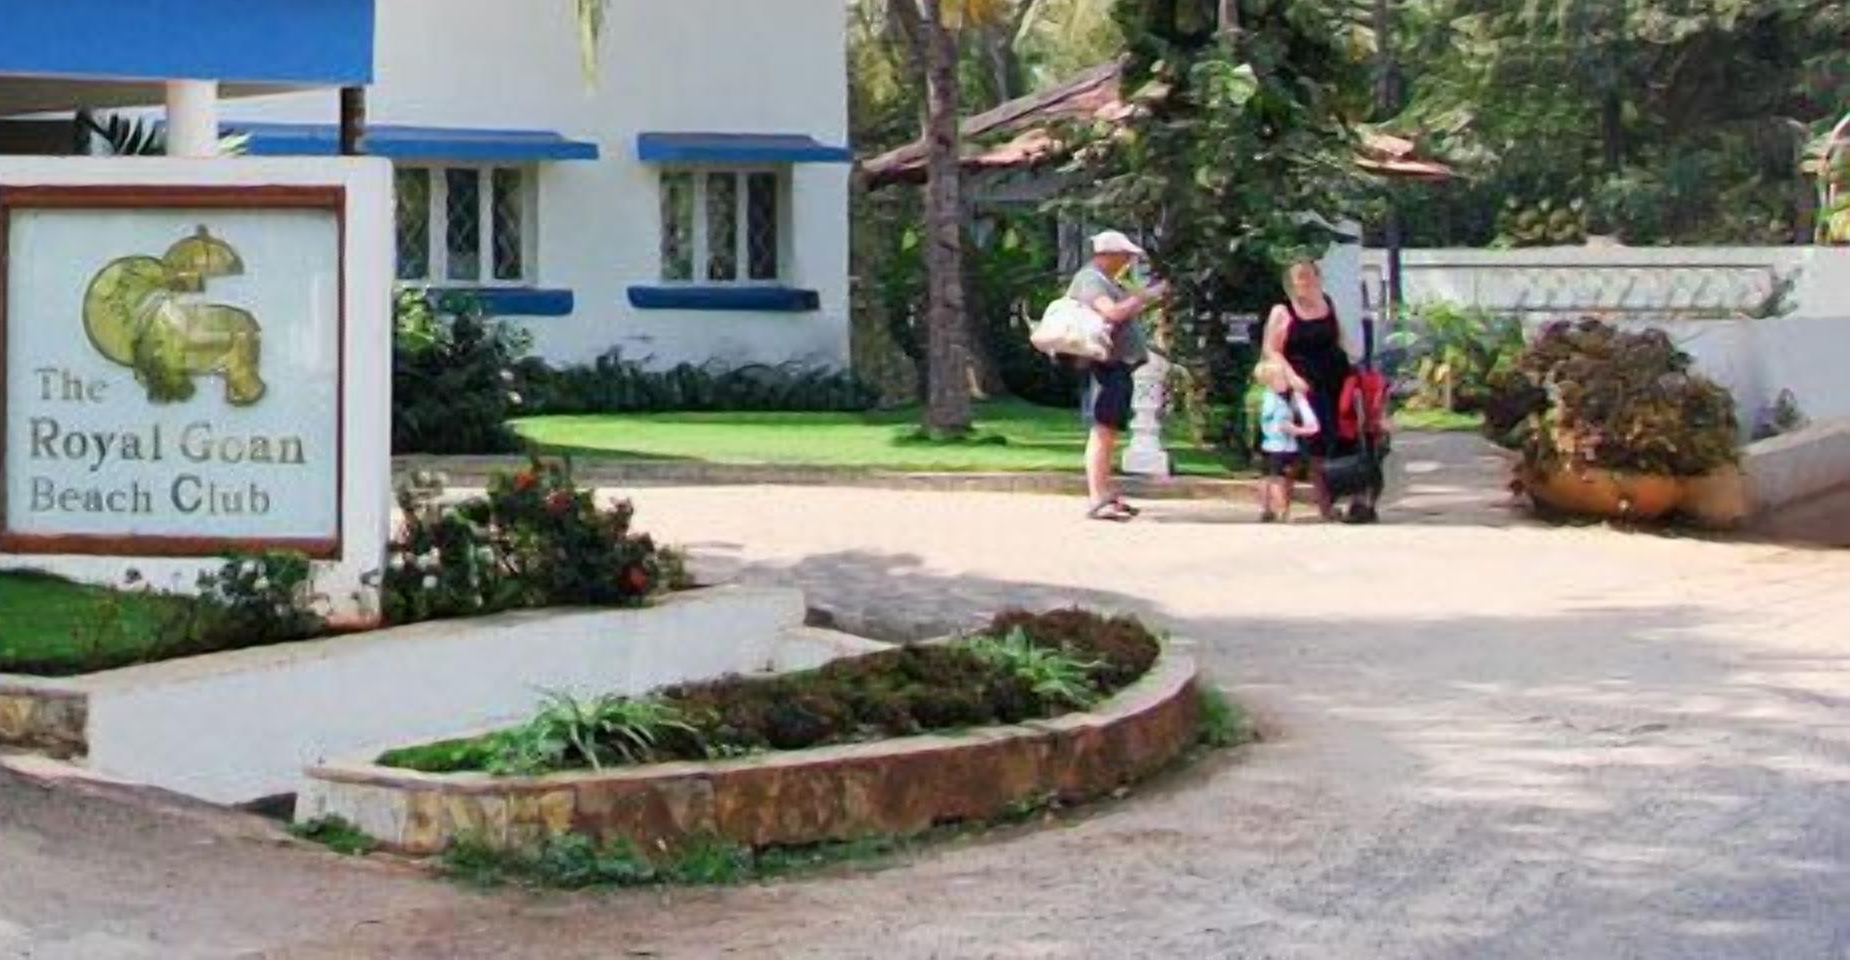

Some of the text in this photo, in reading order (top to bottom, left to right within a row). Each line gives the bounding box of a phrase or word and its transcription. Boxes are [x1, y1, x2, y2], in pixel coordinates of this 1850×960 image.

[34, 367, 109, 402] The
[29, 416, 307, 471] Royal Goan
[29, 473, 272, 515] Beach Club
